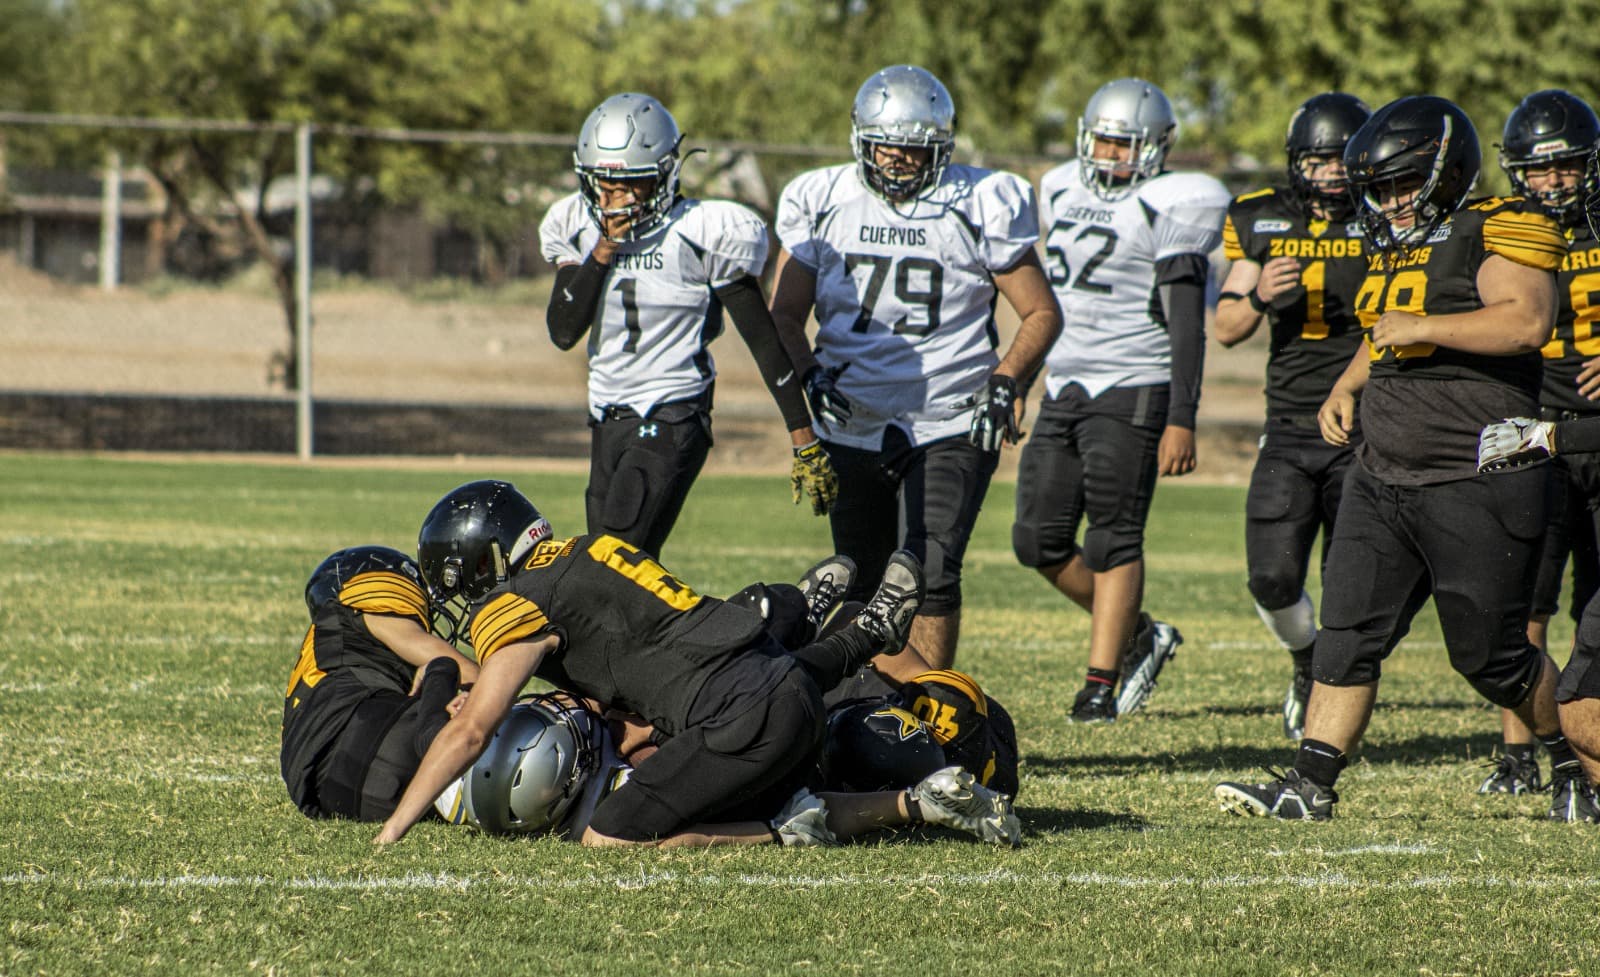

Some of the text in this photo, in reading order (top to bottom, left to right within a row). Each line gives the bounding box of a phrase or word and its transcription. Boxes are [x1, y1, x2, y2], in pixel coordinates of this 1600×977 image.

[611, 252, 664, 270] ERVOS
[860, 225, 927, 246] CUERVOS
[1046, 219, 1119, 295] 52
[1269, 238, 1362, 258] ZORROS
[612, 278, 642, 353] 1
[845, 253, 944, 337] 79
[1301, 261, 1329, 340] 1
[525, 541, 565, 570] CE
